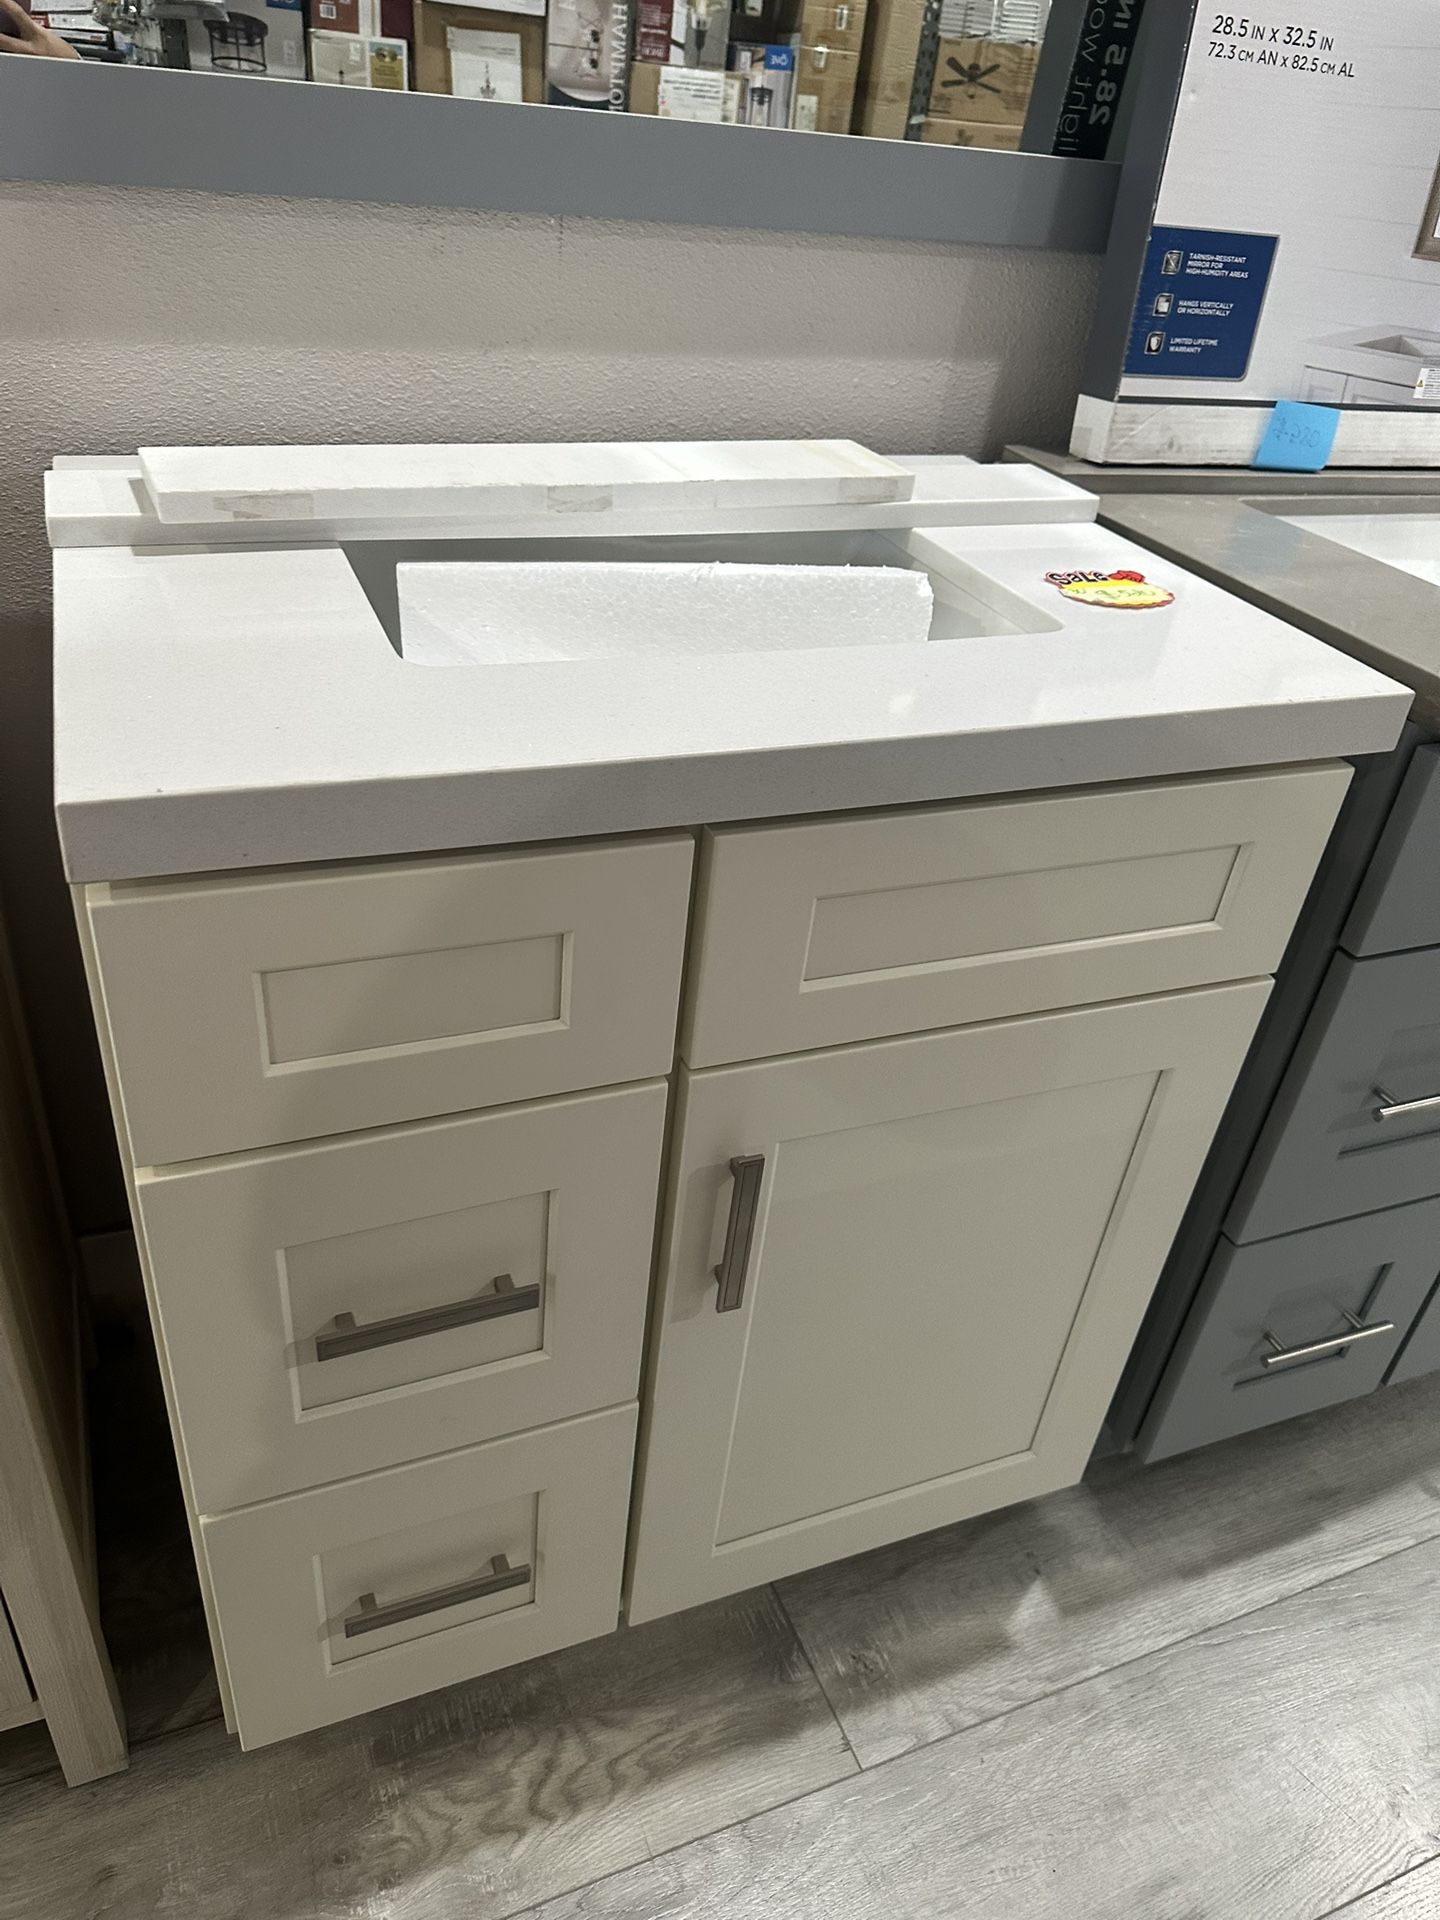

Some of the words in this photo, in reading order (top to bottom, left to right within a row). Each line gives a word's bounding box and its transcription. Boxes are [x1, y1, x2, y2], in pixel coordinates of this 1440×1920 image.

[1212, 15, 1250, 37] 28.5
[1251, 25, 1266, 40] IN
[1283, 26, 1318, 49] 32.5
[1320, 36, 1334, 51] IN
[1208, 42, 1237, 60] 72.3
[1238, 50, 1254, 62] CM
[1256, 50, 1278, 66] AN
[1291, 54, 1319, 72] 82.5
[1320, 63, 1336, 75] CM
[1337, 62, 1355, 78] AL
[1189, 252, 1247, 263] TARNISH-RESISTANT
[1187, 260, 1210, 268] MIRROR
[1185, 268, 1229, 277] HIGH-HUMIDITY
[1229, 271, 1249, 279] AREAS
[1200, 301, 1234, 309] VERTICALLY
[1186, 308, 1231, 317] HORIZONTALLY
[1170, 337, 1193, 345] LIMITED
[1193, 338, 1218, 347] LIFETIME
